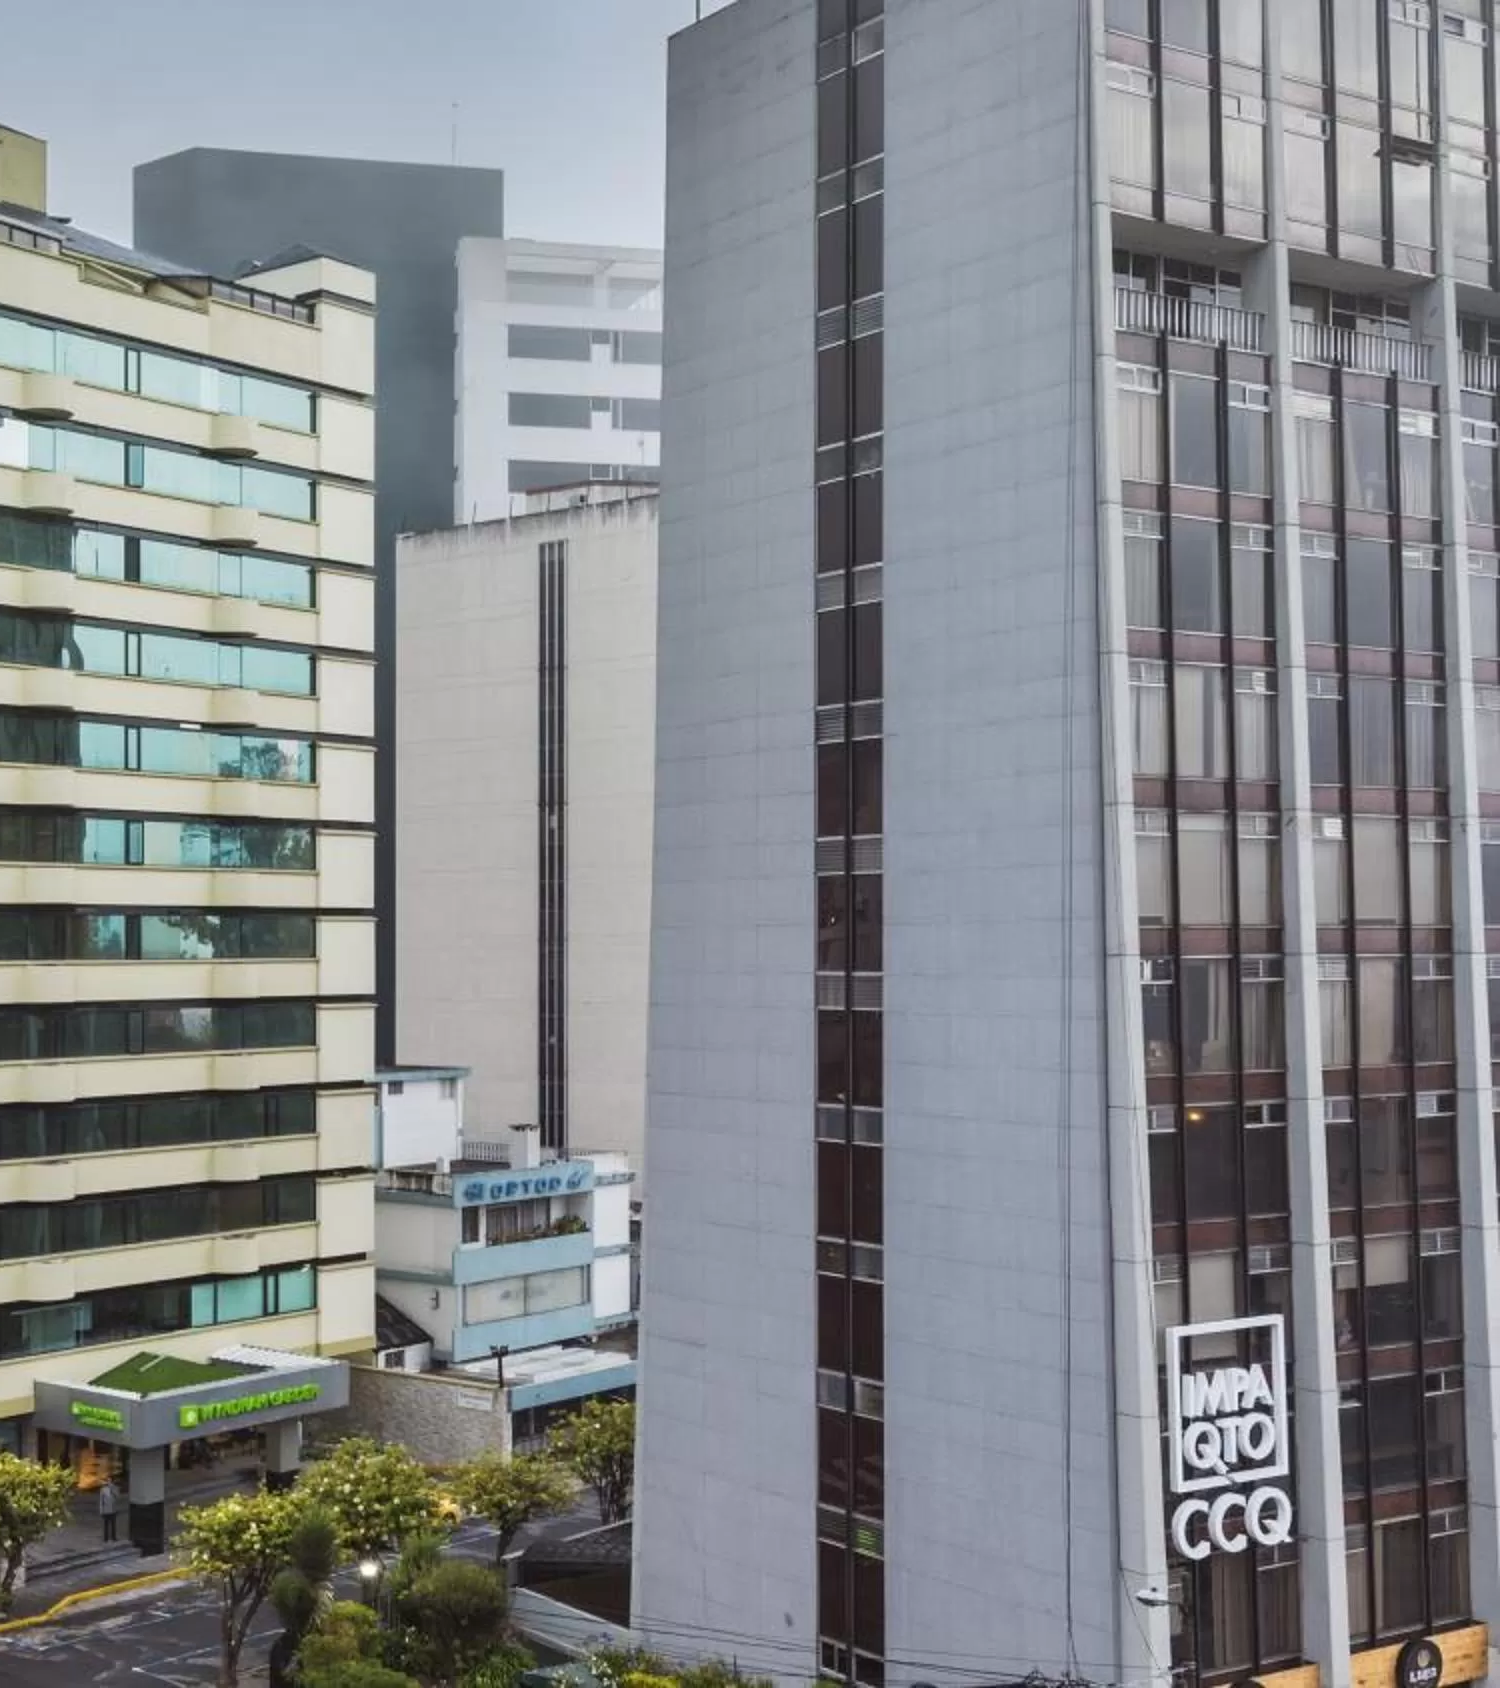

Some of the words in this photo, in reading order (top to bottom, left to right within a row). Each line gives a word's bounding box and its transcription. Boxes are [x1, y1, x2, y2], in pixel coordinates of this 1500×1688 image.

[1181, 1363, 1274, 1418] IMPA
[1183, 1411, 1276, 1476] QTO
[1171, 1486, 1294, 1561] CCQ
